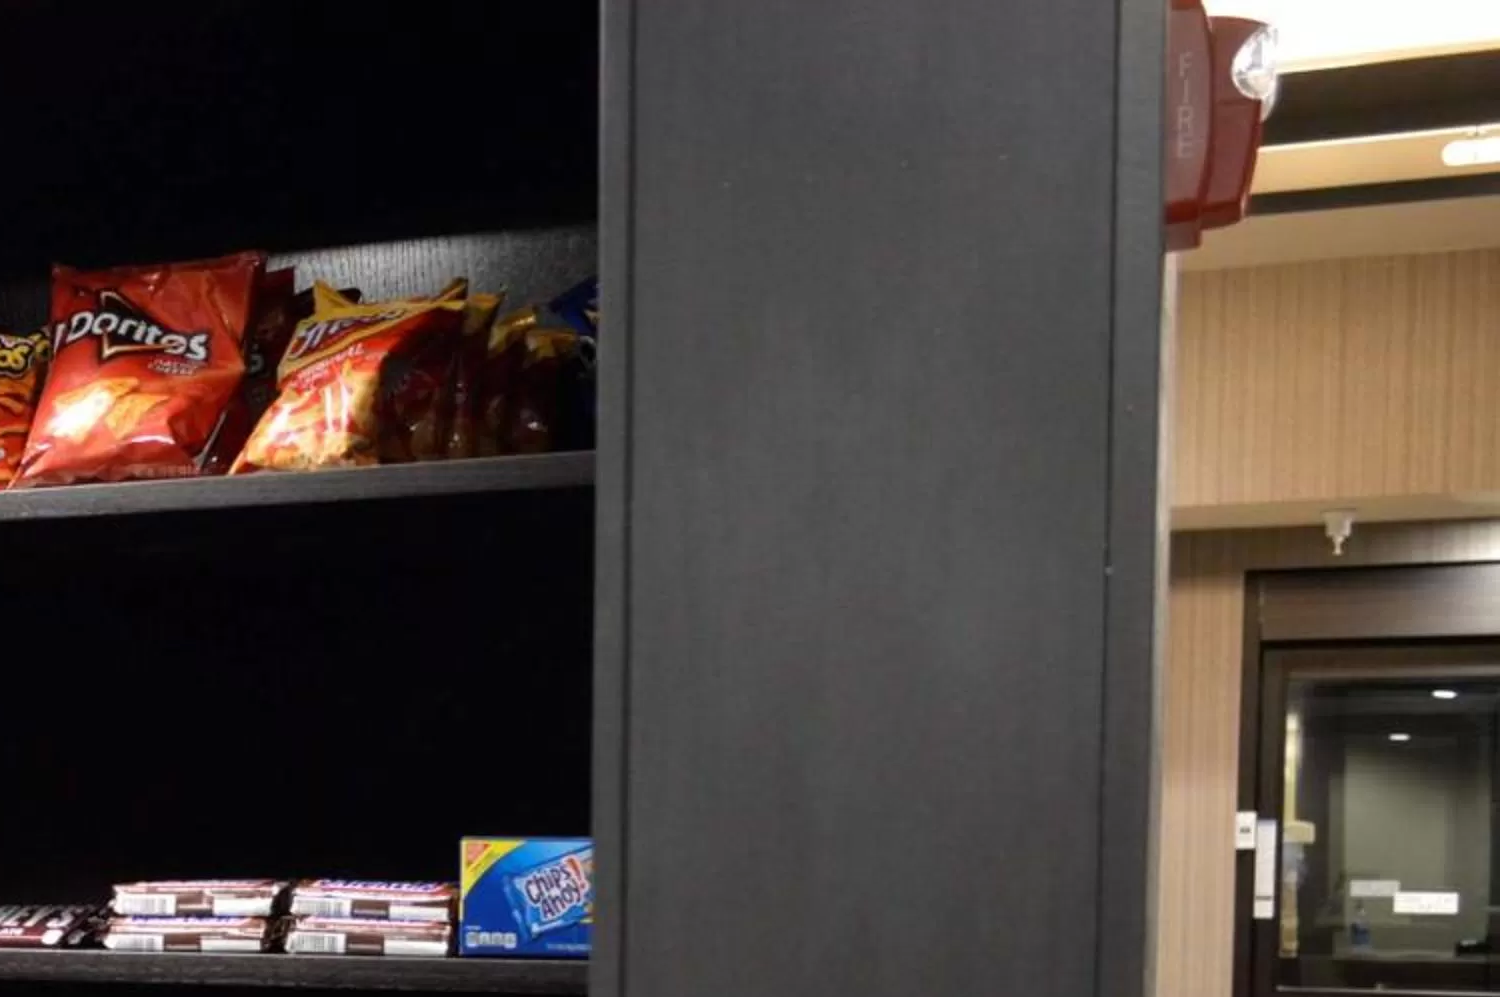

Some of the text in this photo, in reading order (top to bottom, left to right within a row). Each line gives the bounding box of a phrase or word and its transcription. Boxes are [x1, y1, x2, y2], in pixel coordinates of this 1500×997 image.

[1177, 52, 1194, 158] FIRE
[66, 311, 209, 361] Doritos
[525, 865, 571, 904] Chips
